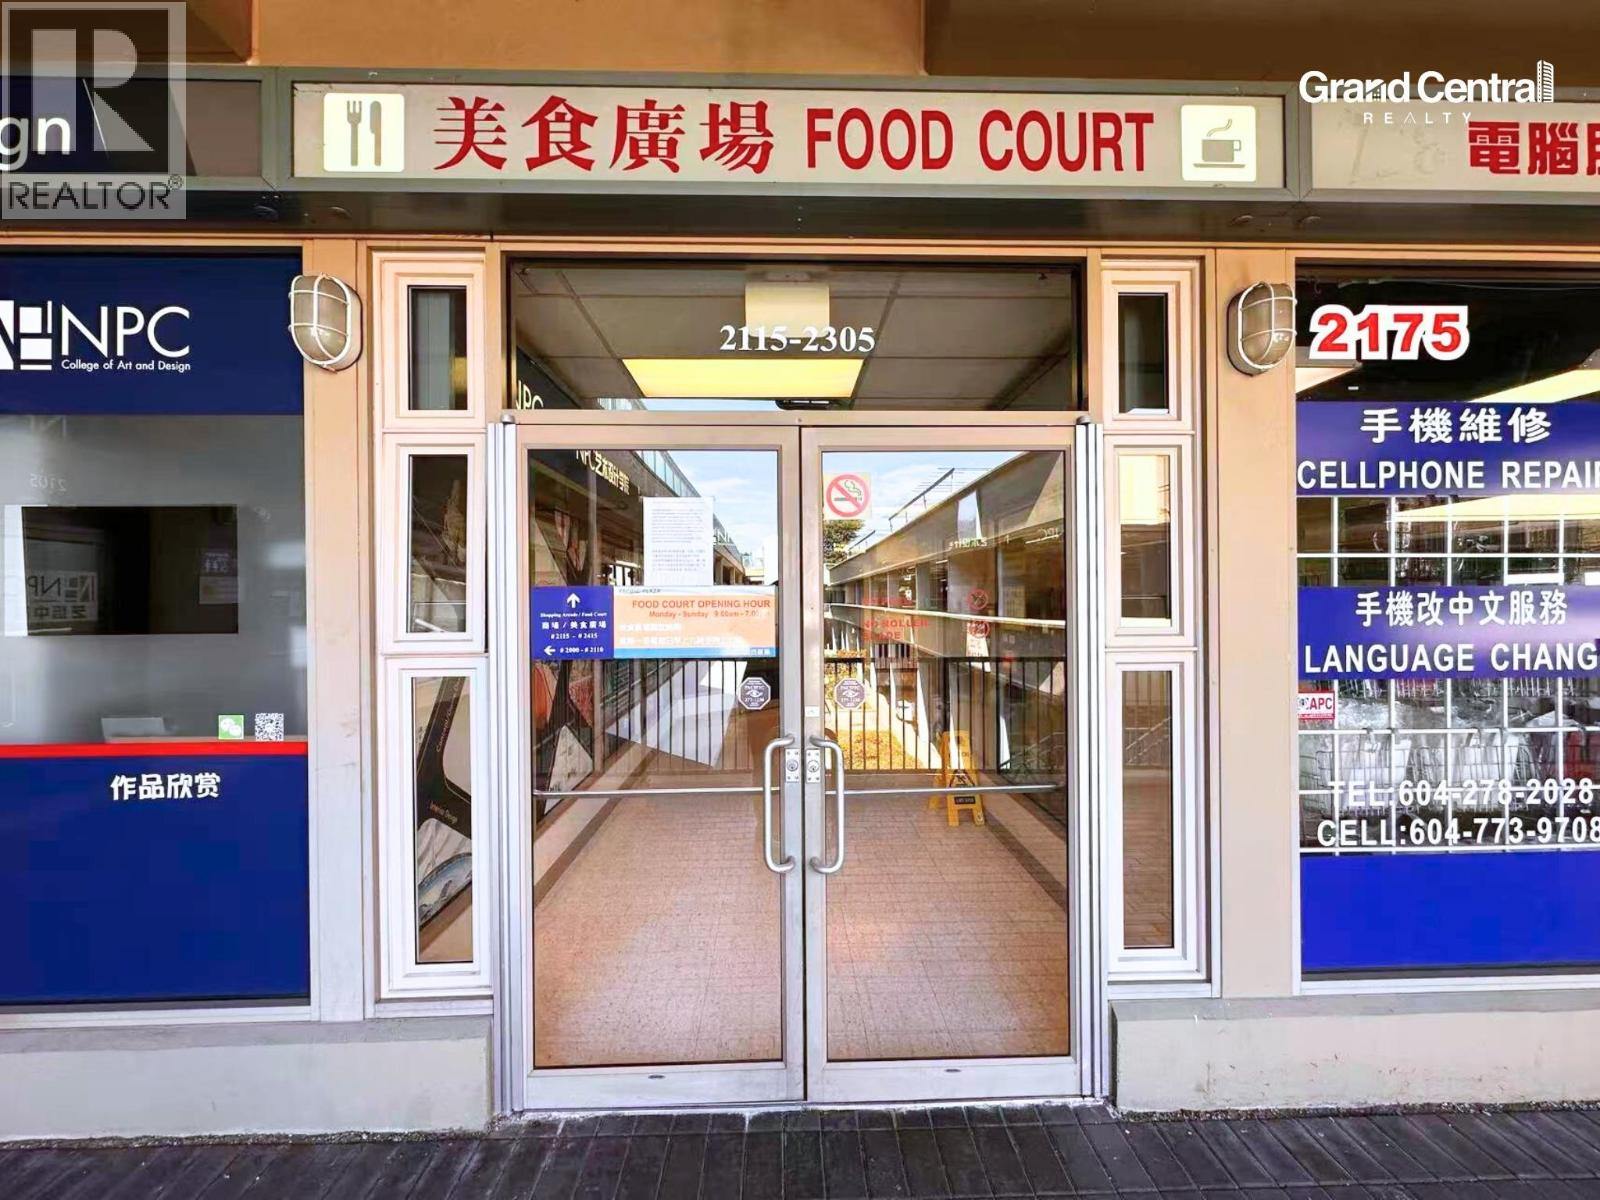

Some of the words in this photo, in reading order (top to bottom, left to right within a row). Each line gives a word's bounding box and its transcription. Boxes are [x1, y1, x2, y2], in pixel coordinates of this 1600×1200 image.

[433, 95, 774, 174] 美食廣場
[806, 107, 954, 170] FOOD
[979, 109, 1155, 172] COURT
[1468, 121, 1600, 176] 電腦
[61, 303, 191, 358] NPC
[719, 325, 876, 352] 2115-2305
[1312, 307, 1466, 358] 2175
[61, 359, 100, 373] College
[103, 359, 114, 371] of
[117, 360, 132, 371] Art
[135, 360, 155, 371] and
[158, 360, 191, 373] Design
[1360, 407, 1552, 443] 手機維修
[1297, 460, 1485, 489] CELLPHONE
[632, 599, 659, 608] FOOD
[661, 599, 695, 608] COURT
[697, 599, 740, 608] OPENING
[743, 599, 770, 608] HOUR
[649, 610, 676, 619] Monday
[682, 610, 708, 619] Sunday
[1355, 588, 1568, 627] 手機改中文服務
[1305, 643, 1475, 673] LANGUAGE
[1491, 642, 1598, 672] CHANG
[1310, 697, 1333, 710] APC
[110, 772, 221, 802] 作品欣赏
